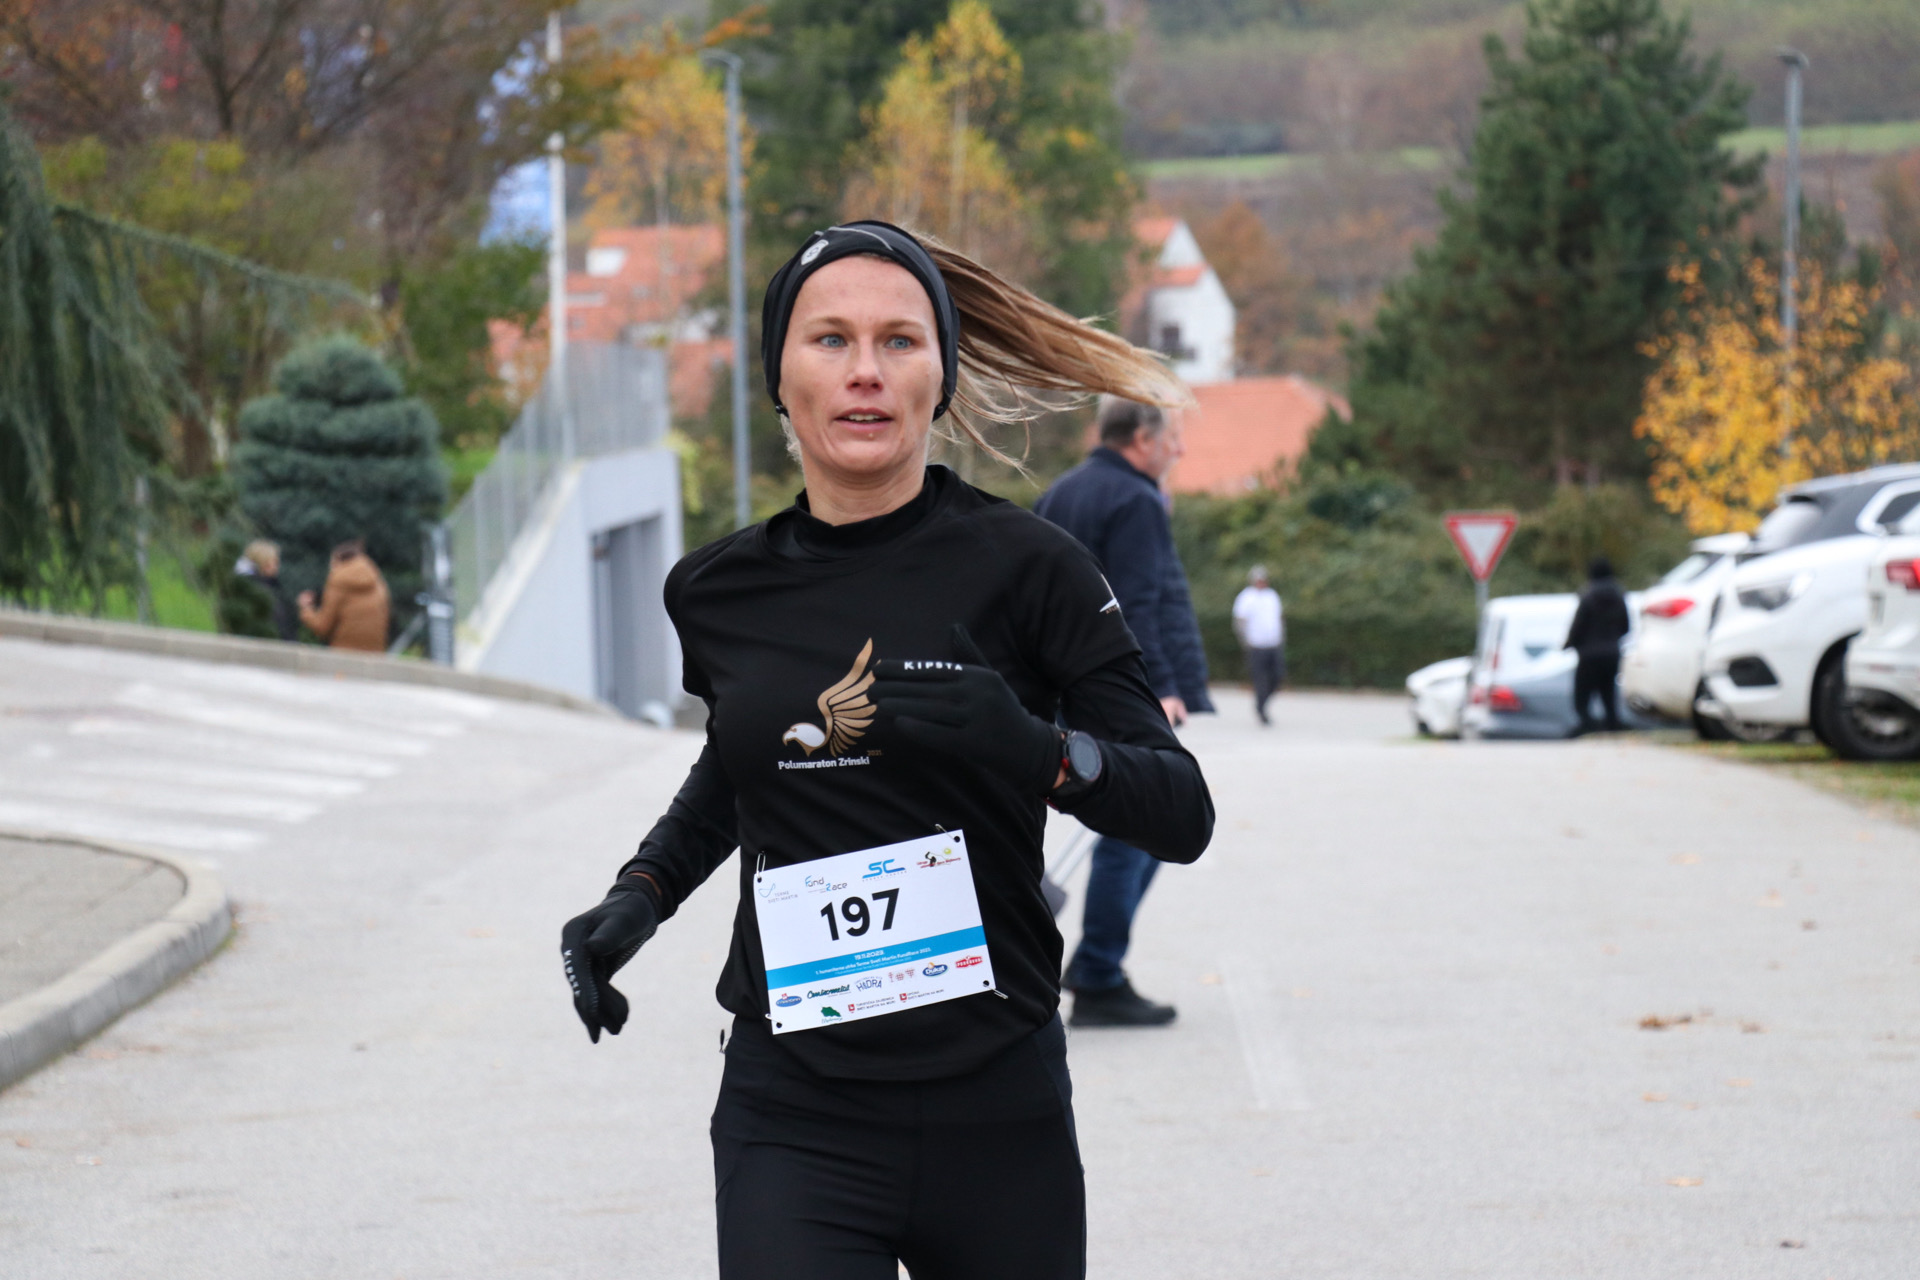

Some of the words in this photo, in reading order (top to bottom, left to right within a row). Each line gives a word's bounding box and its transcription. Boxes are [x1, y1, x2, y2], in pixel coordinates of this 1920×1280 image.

[904, 660, 964, 672] KIPSTA
[778, 759, 837, 771] Polumaraton
[838, 756, 871, 768] Zrinski
[862, 859, 906, 879] SC
[805, 875, 825, 887] Fund
[820, 887, 900, 941] 197
[925, 965, 945, 975] Dukat
